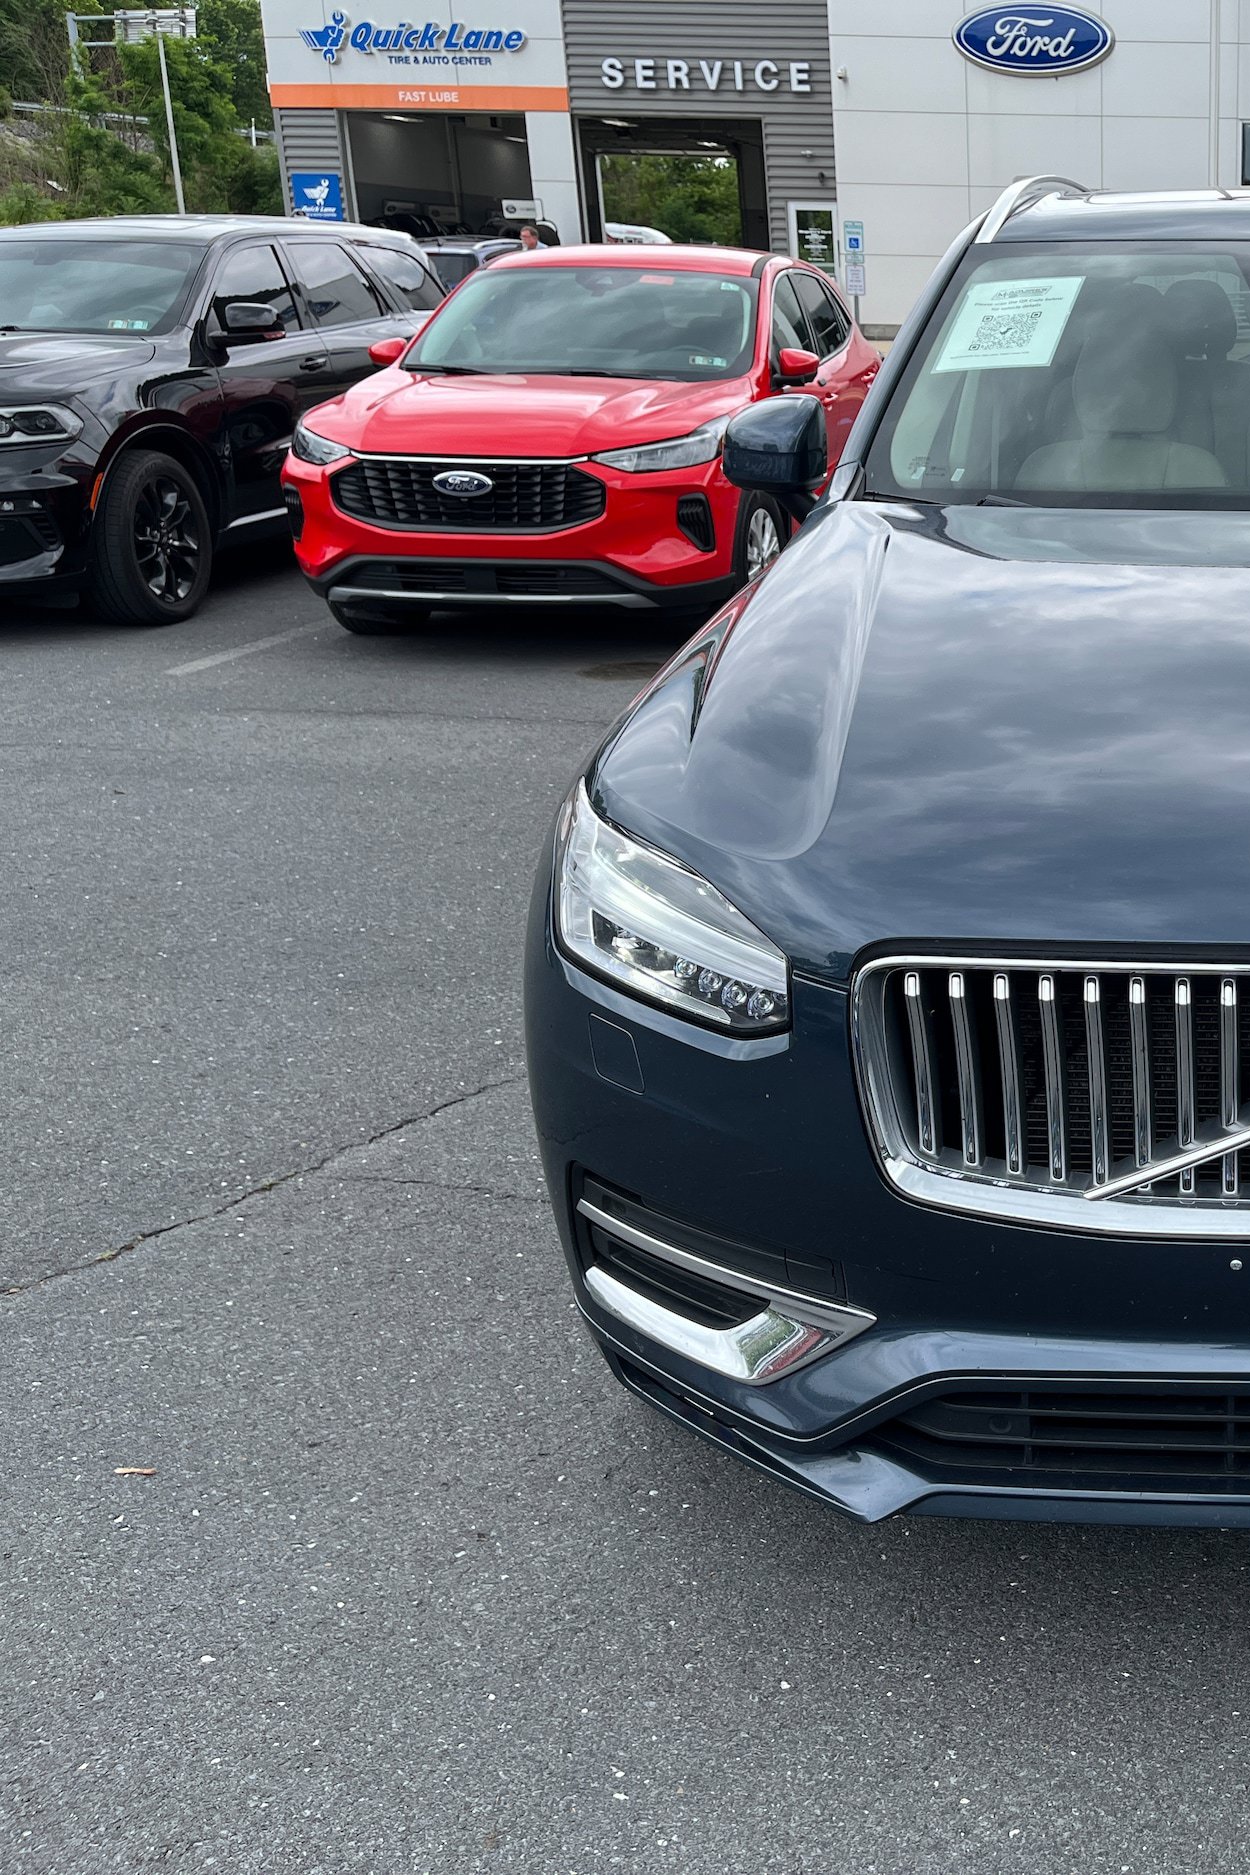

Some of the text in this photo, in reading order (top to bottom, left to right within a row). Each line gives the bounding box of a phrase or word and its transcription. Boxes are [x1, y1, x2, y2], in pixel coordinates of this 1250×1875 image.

[350, 22, 524, 51] Quick Lane
[986, 16, 1077, 58] Ford
[388, 55, 492, 66] TIRE & AUTO CENTER
[601, 57, 812, 92] SERVICE
[398, 91, 460, 103] FAST LUBE
[446, 475, 478, 491] Ford
